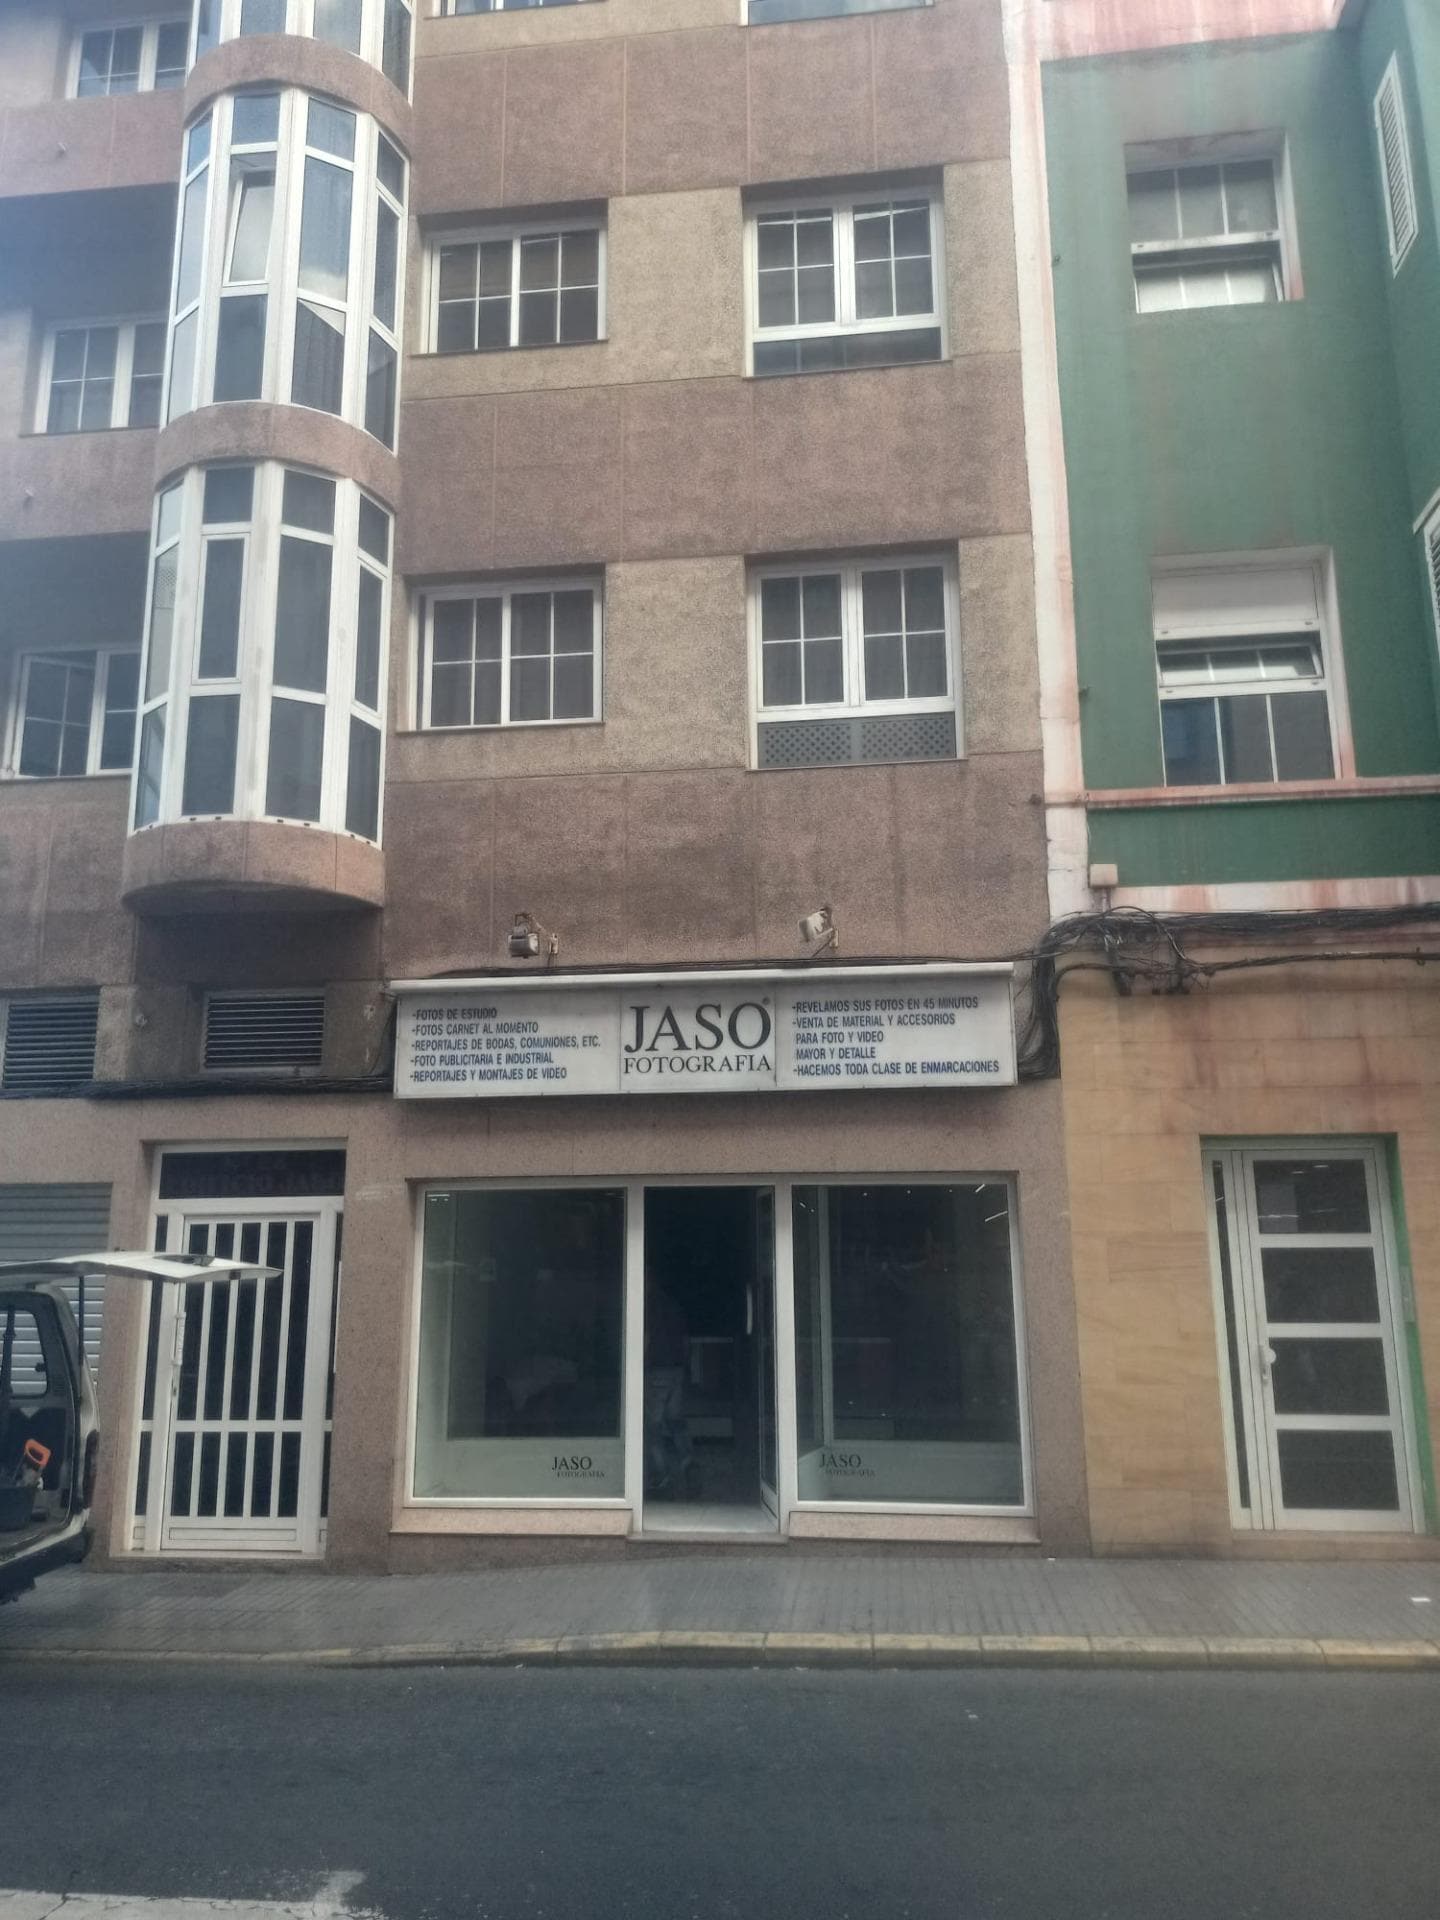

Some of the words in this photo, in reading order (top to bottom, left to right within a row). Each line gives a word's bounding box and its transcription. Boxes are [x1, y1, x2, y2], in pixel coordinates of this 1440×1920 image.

[853, 1000, 871, 1011] SUS
[875, 999, 904, 1011] FOTOS
[908, 998, 920, 1009] EN
[923, 998, 935, 1009] 45
[938, 997, 978, 1009] MINUTOS
[447, 1009, 458, 1019] DE
[461, 1008, 497, 1019] ESTUDIO
[827, 1016, 839, 1027] DE
[842, 1015, 884, 1027] MATERIAL
[888, 1015, 894, 1026] Y
[897, 1013, 955, 1026] ACCESORIOS
[446, 1023, 479, 1035] CARNET
[483, 1023, 493, 1034] AL
[496, 1022, 538, 1033] MOMENTO
[624, 1003, 771, 1053] JASO
[472, 1039, 482, 1049] DE
[486, 1038, 517, 1050] BODAS,
[520, 1036, 579, 1049] COMUNIONES,
[582, 1036, 600, 1047] ETC.
[796, 1032, 818, 1043] PARA
[822, 1032, 845, 1043] FOTO
[848, 1032, 854, 1042] Y
[857, 1031, 884, 1042] VIDEO
[439, 1053, 493, 1065] PUBLICITARIA
[497, 1053, 502, 1064] E
[506, 1052, 553, 1064] INDUSTRIAL
[796, 1048, 826, 1060] MAYOR
[829, 1048, 835, 1059] Y
[839, 1047, 876, 1059] DETALLE
[624, 1055, 771, 1074] FOTOGRAFIA
[845, 1063, 868, 1074] TODA
[872, 1062, 901, 1074] CLASE
[905, 1062, 917, 1073] DE
[921, 1060, 999, 1073] ENMARCACIONES
[470, 1070, 476, 1080] Y
[479, 1068, 523, 1080] MONTAJES
[527, 1068, 538, 1079] DE
[541, 1067, 567, 1079] VIDEO
[551, 1456, 592, 1470] JASO
[819, 1453, 861, 1468] JASO
